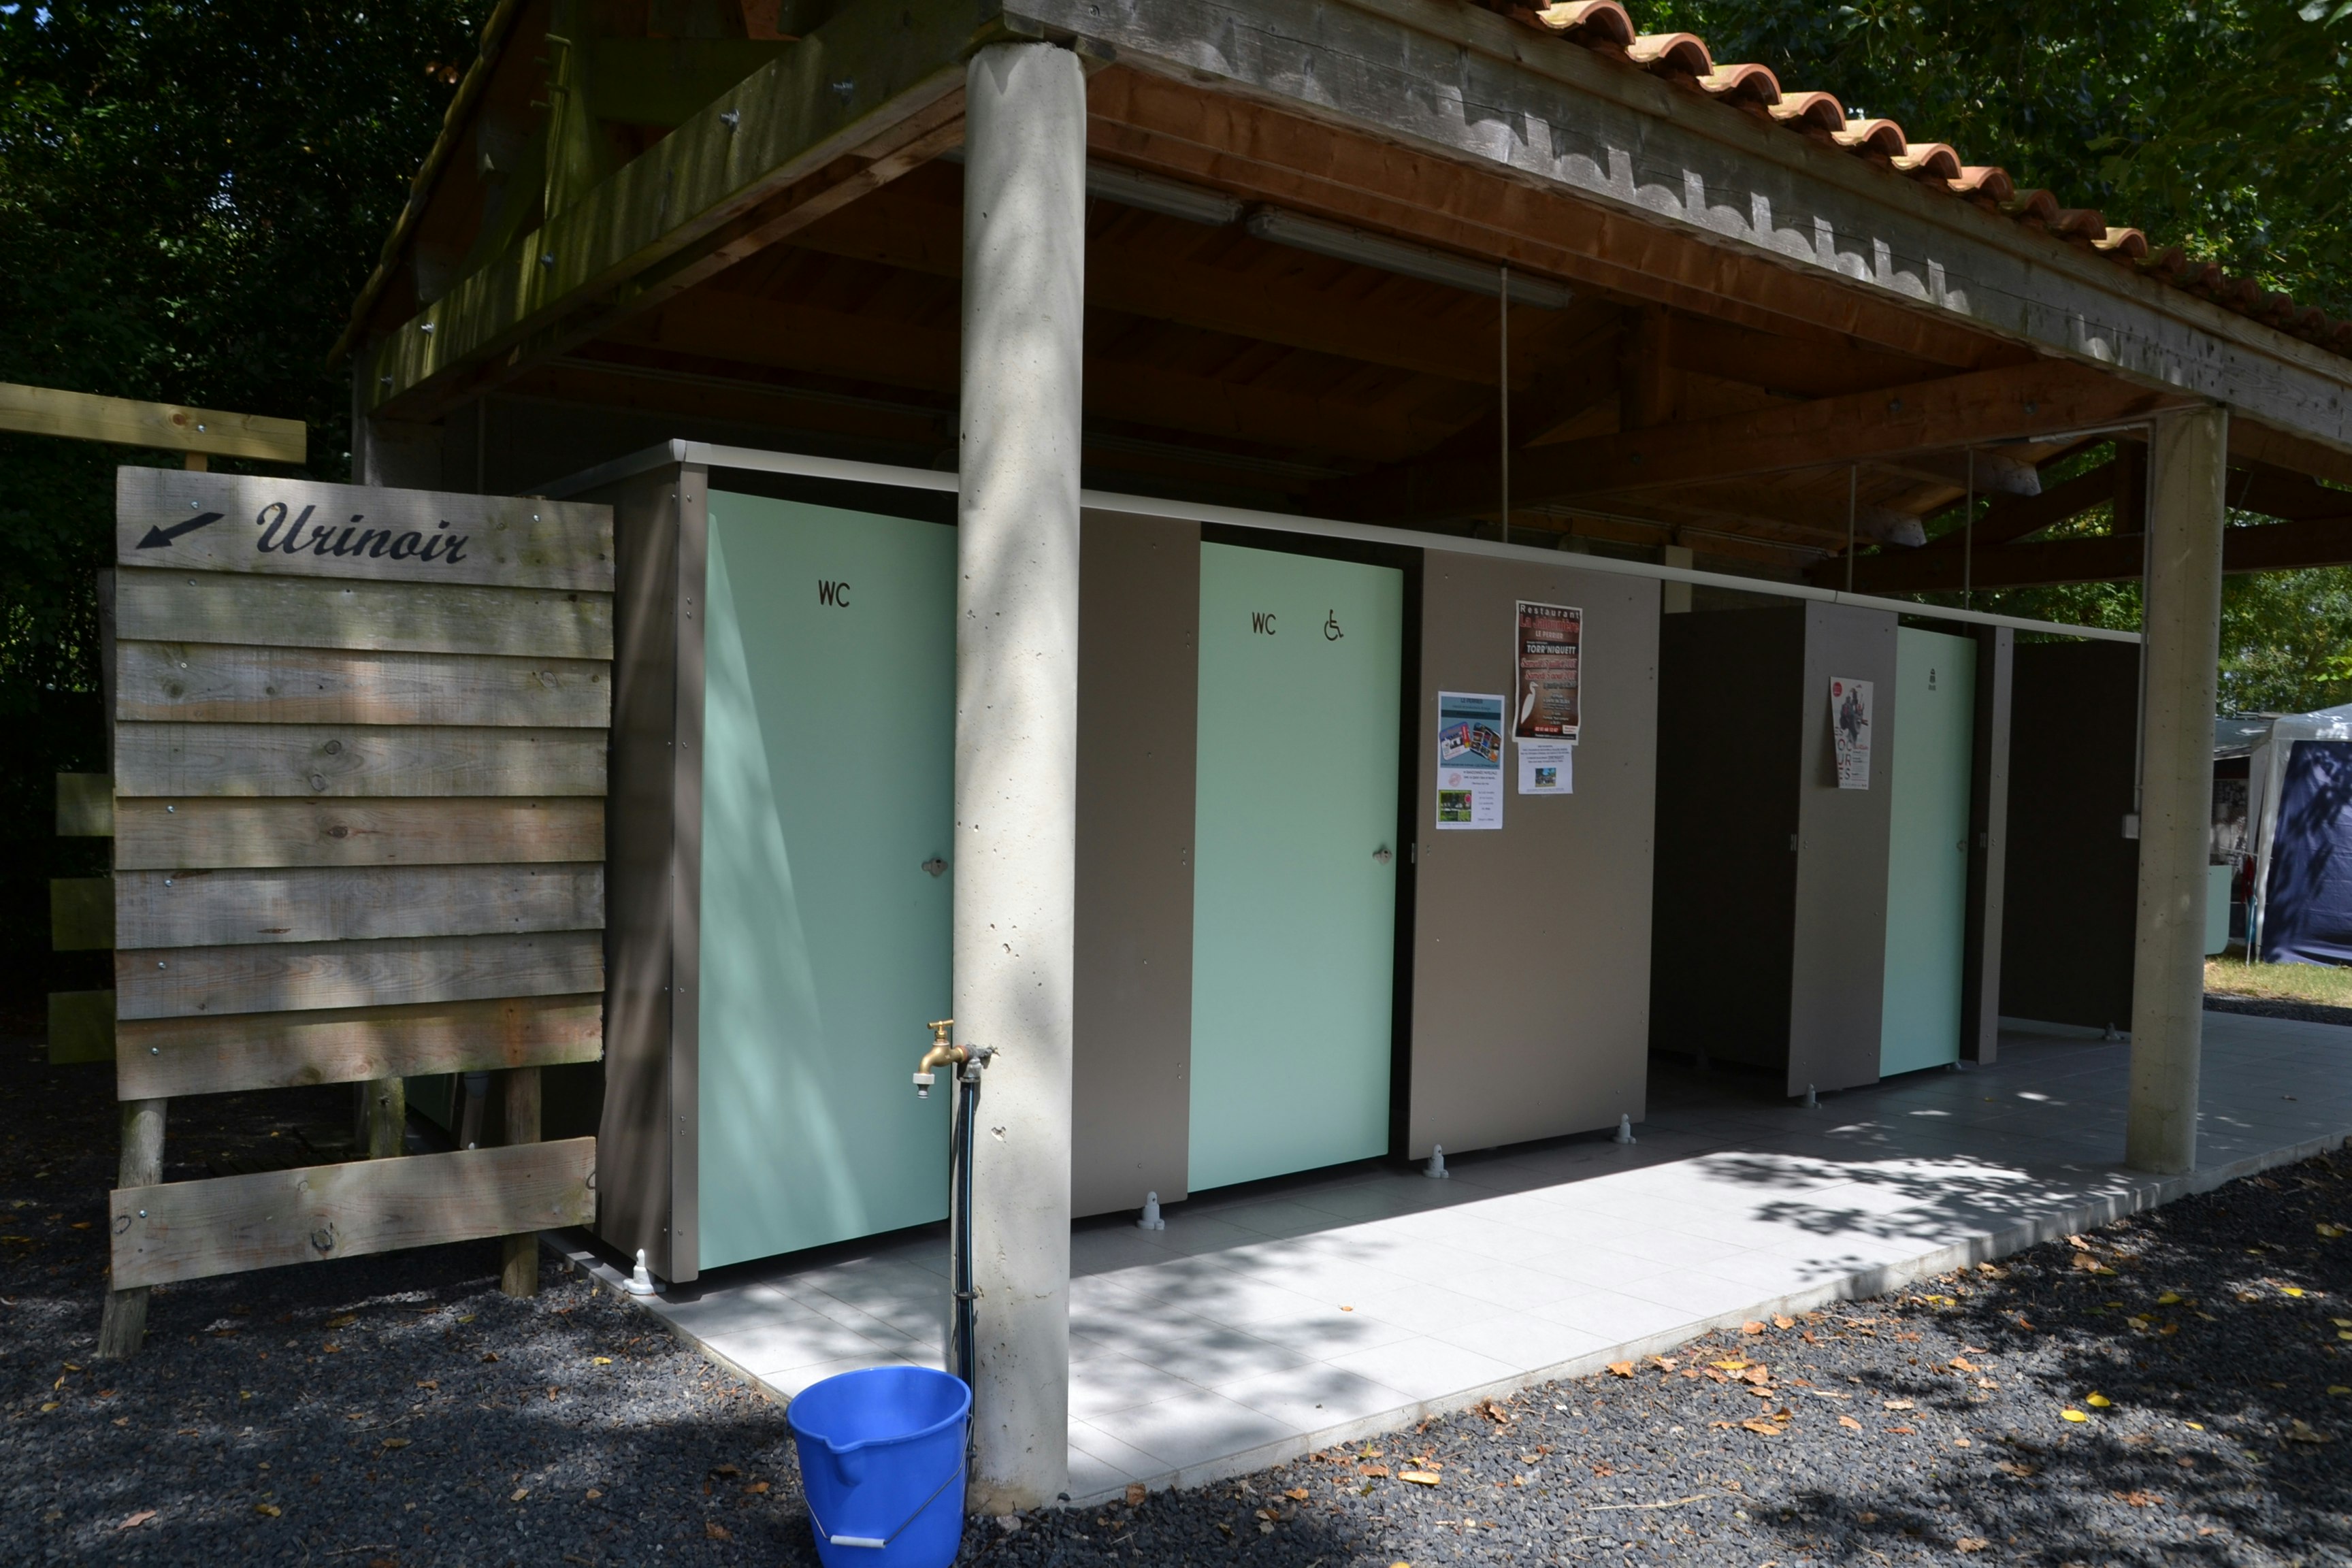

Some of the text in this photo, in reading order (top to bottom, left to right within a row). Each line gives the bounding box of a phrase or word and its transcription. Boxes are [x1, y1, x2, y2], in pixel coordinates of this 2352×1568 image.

[257, 502, 468, 564] Urinoir
[819, 580, 850, 607] WC
[1520, 604, 1579, 619] Restaurant
[1252, 612, 1276, 635] WC
[1520, 613, 1531, 627] La
[1542, 631, 1563, 639] PERRIER
[1526, 644, 1576, 654] TORR'NIQUETT
